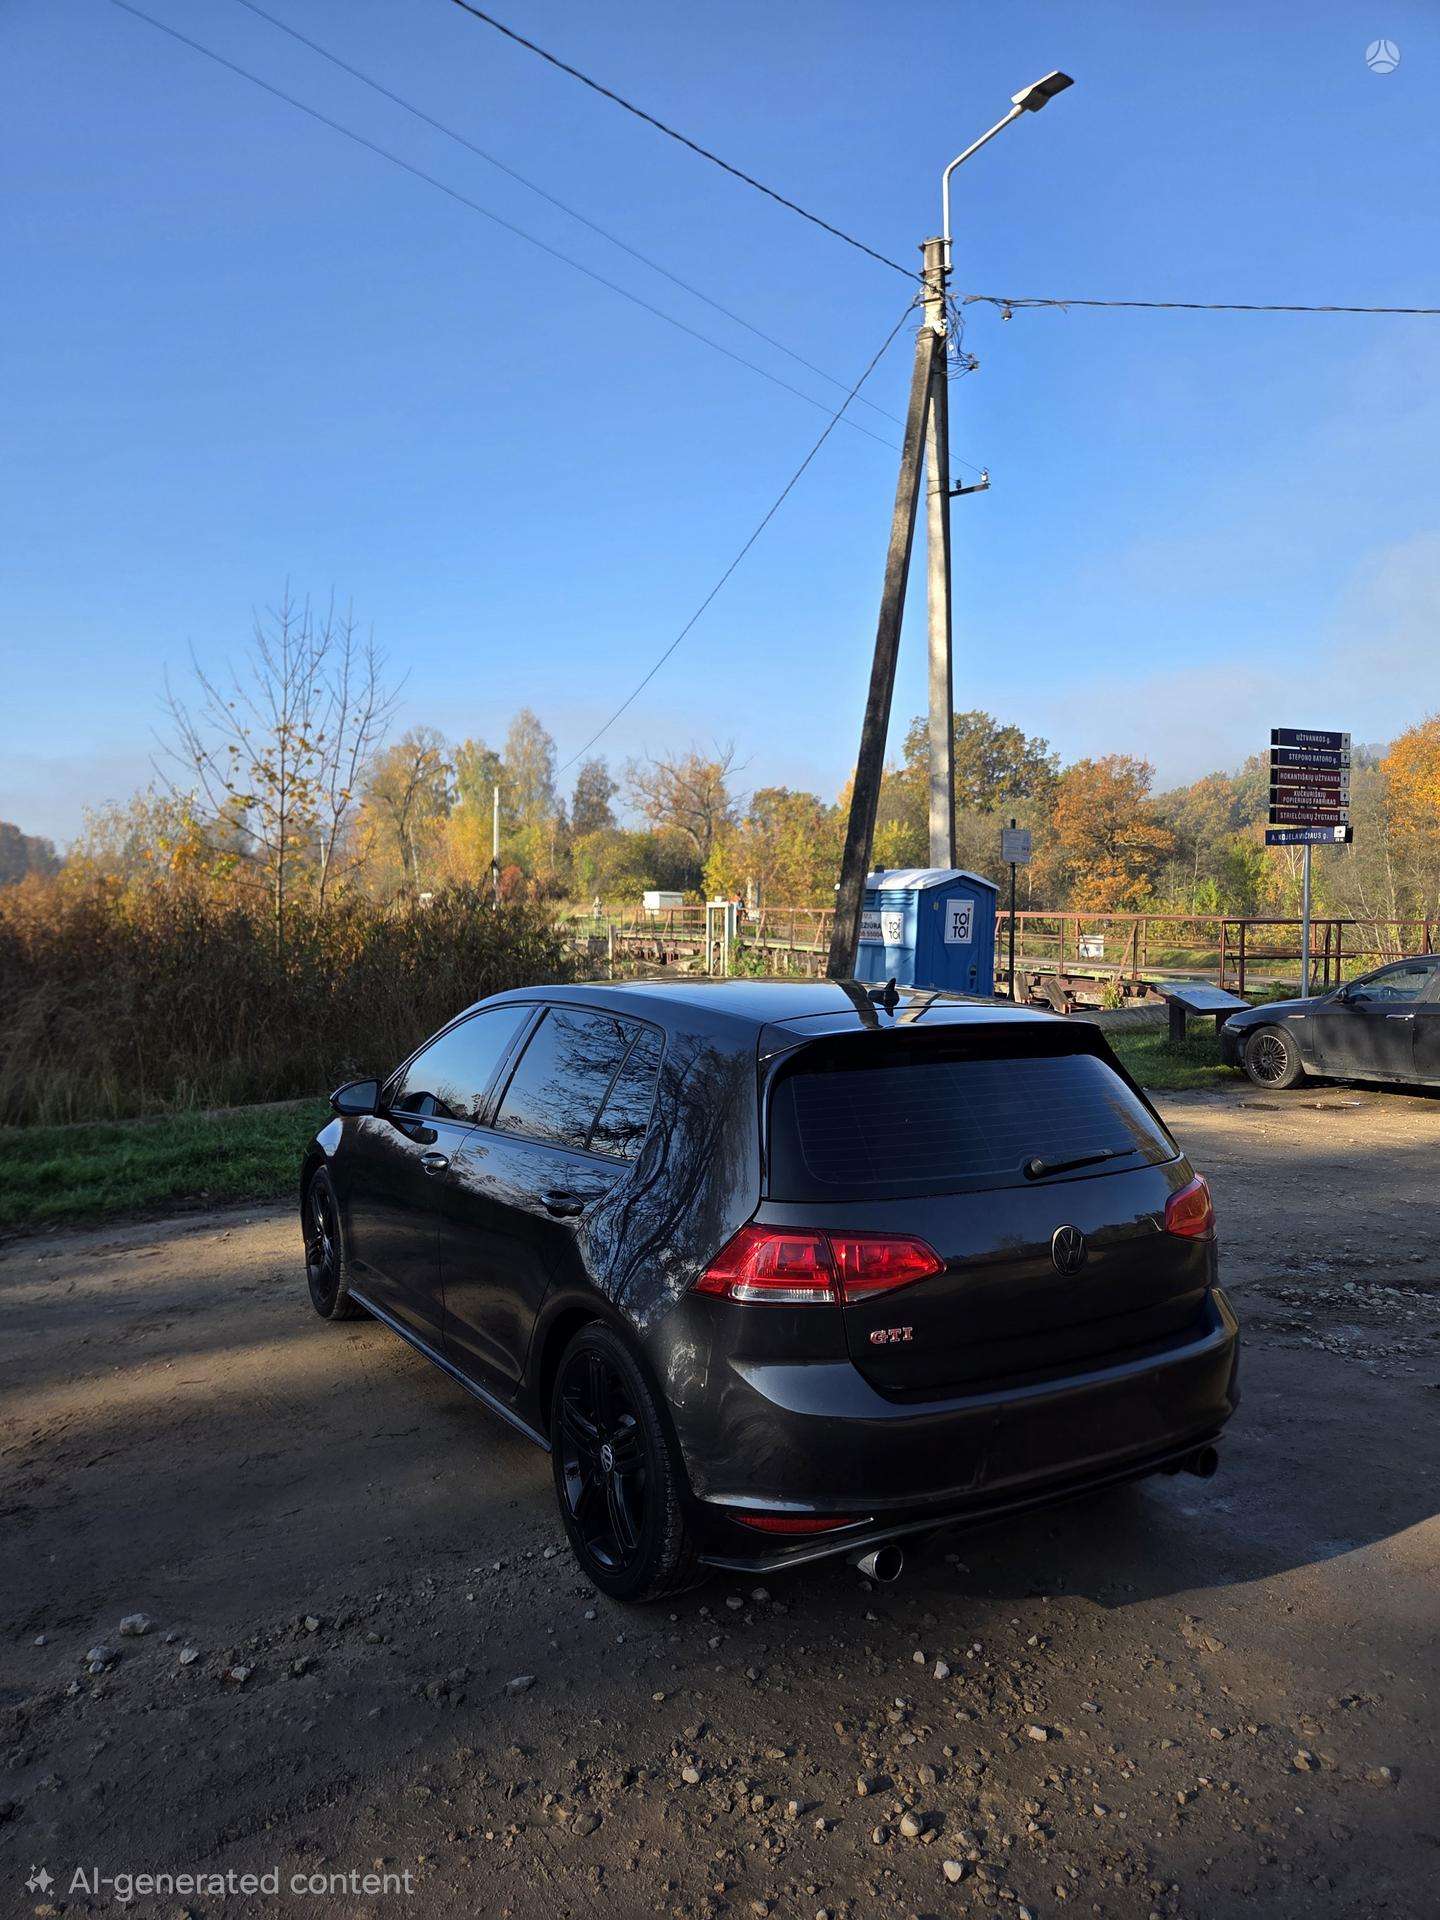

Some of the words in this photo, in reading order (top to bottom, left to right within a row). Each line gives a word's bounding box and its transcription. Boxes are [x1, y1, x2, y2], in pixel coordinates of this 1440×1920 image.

[1295, 733, 1326, 743] UŽTVANKOS
[1288, 752, 1312, 762] STEPONO
[870, 1326, 913, 1345] GTI
